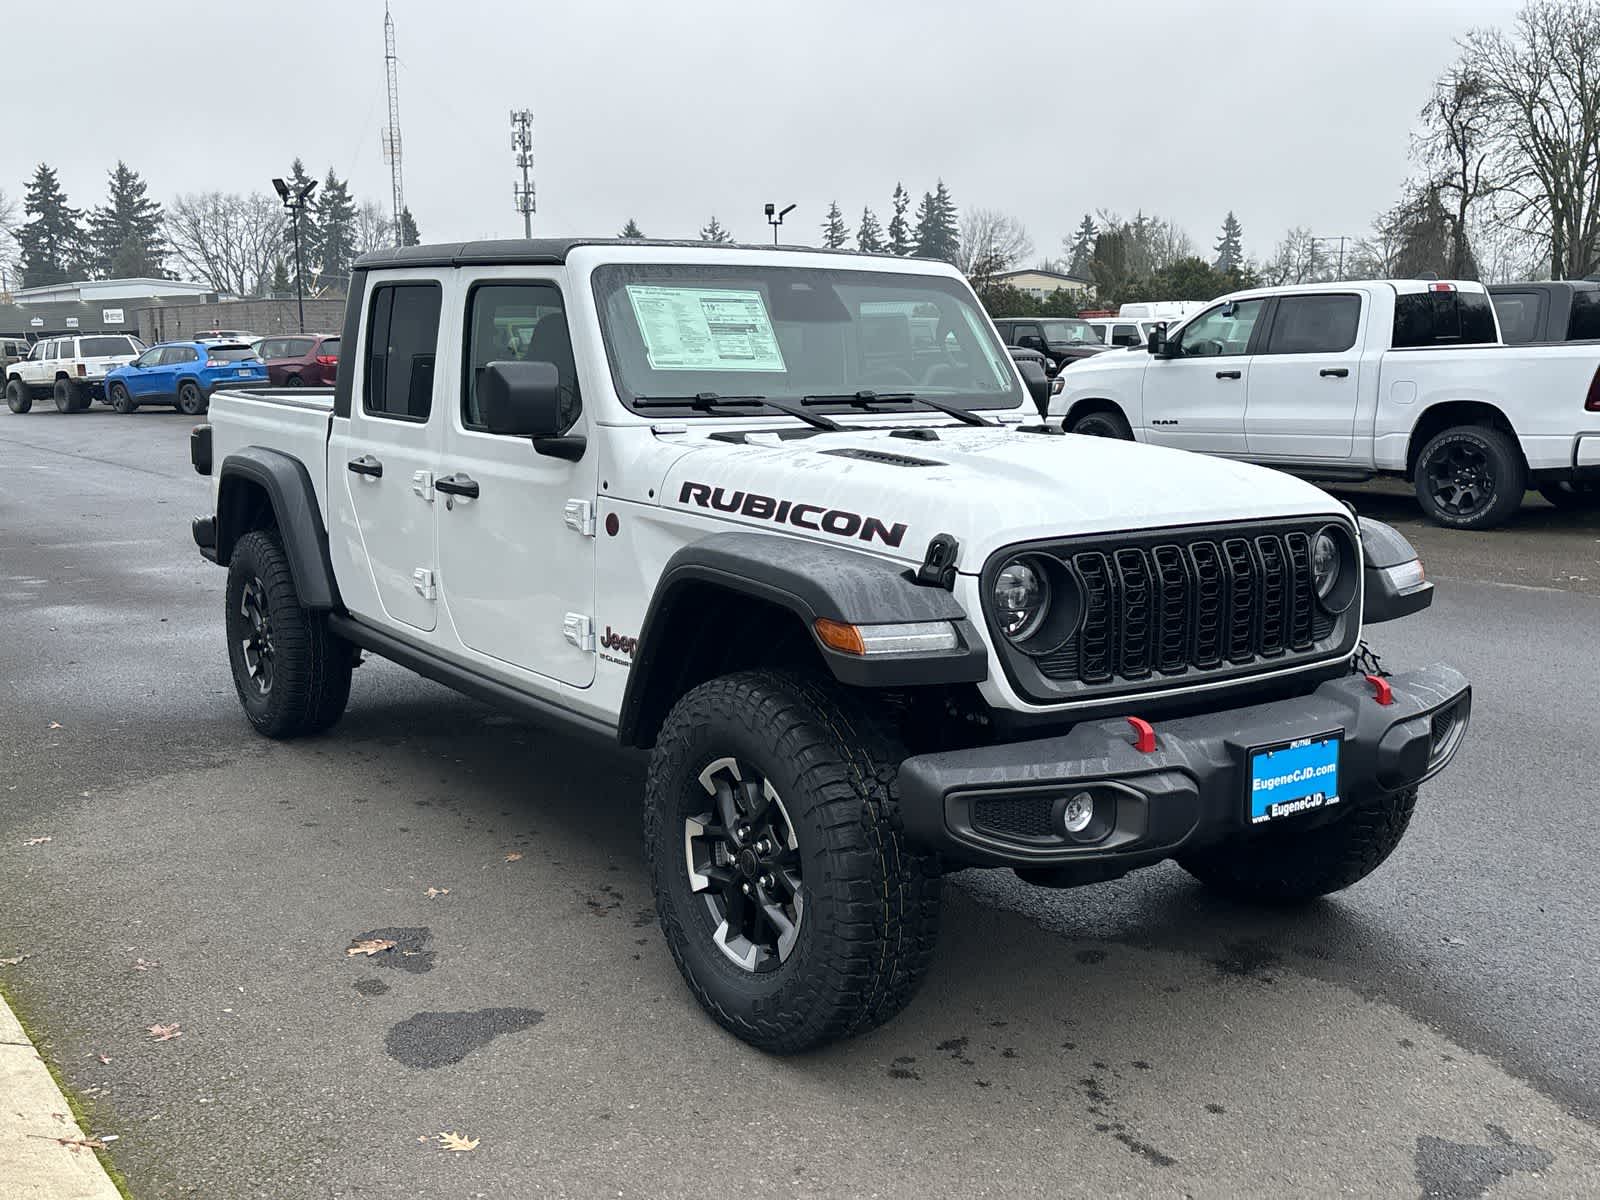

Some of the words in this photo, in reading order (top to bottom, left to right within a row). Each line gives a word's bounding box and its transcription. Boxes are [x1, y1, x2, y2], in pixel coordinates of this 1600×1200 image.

[679, 481, 908, 548] RUBICON
[600, 626, 637, 659] Jeep
[1253, 763, 1336, 791] EugeneCJD.com
